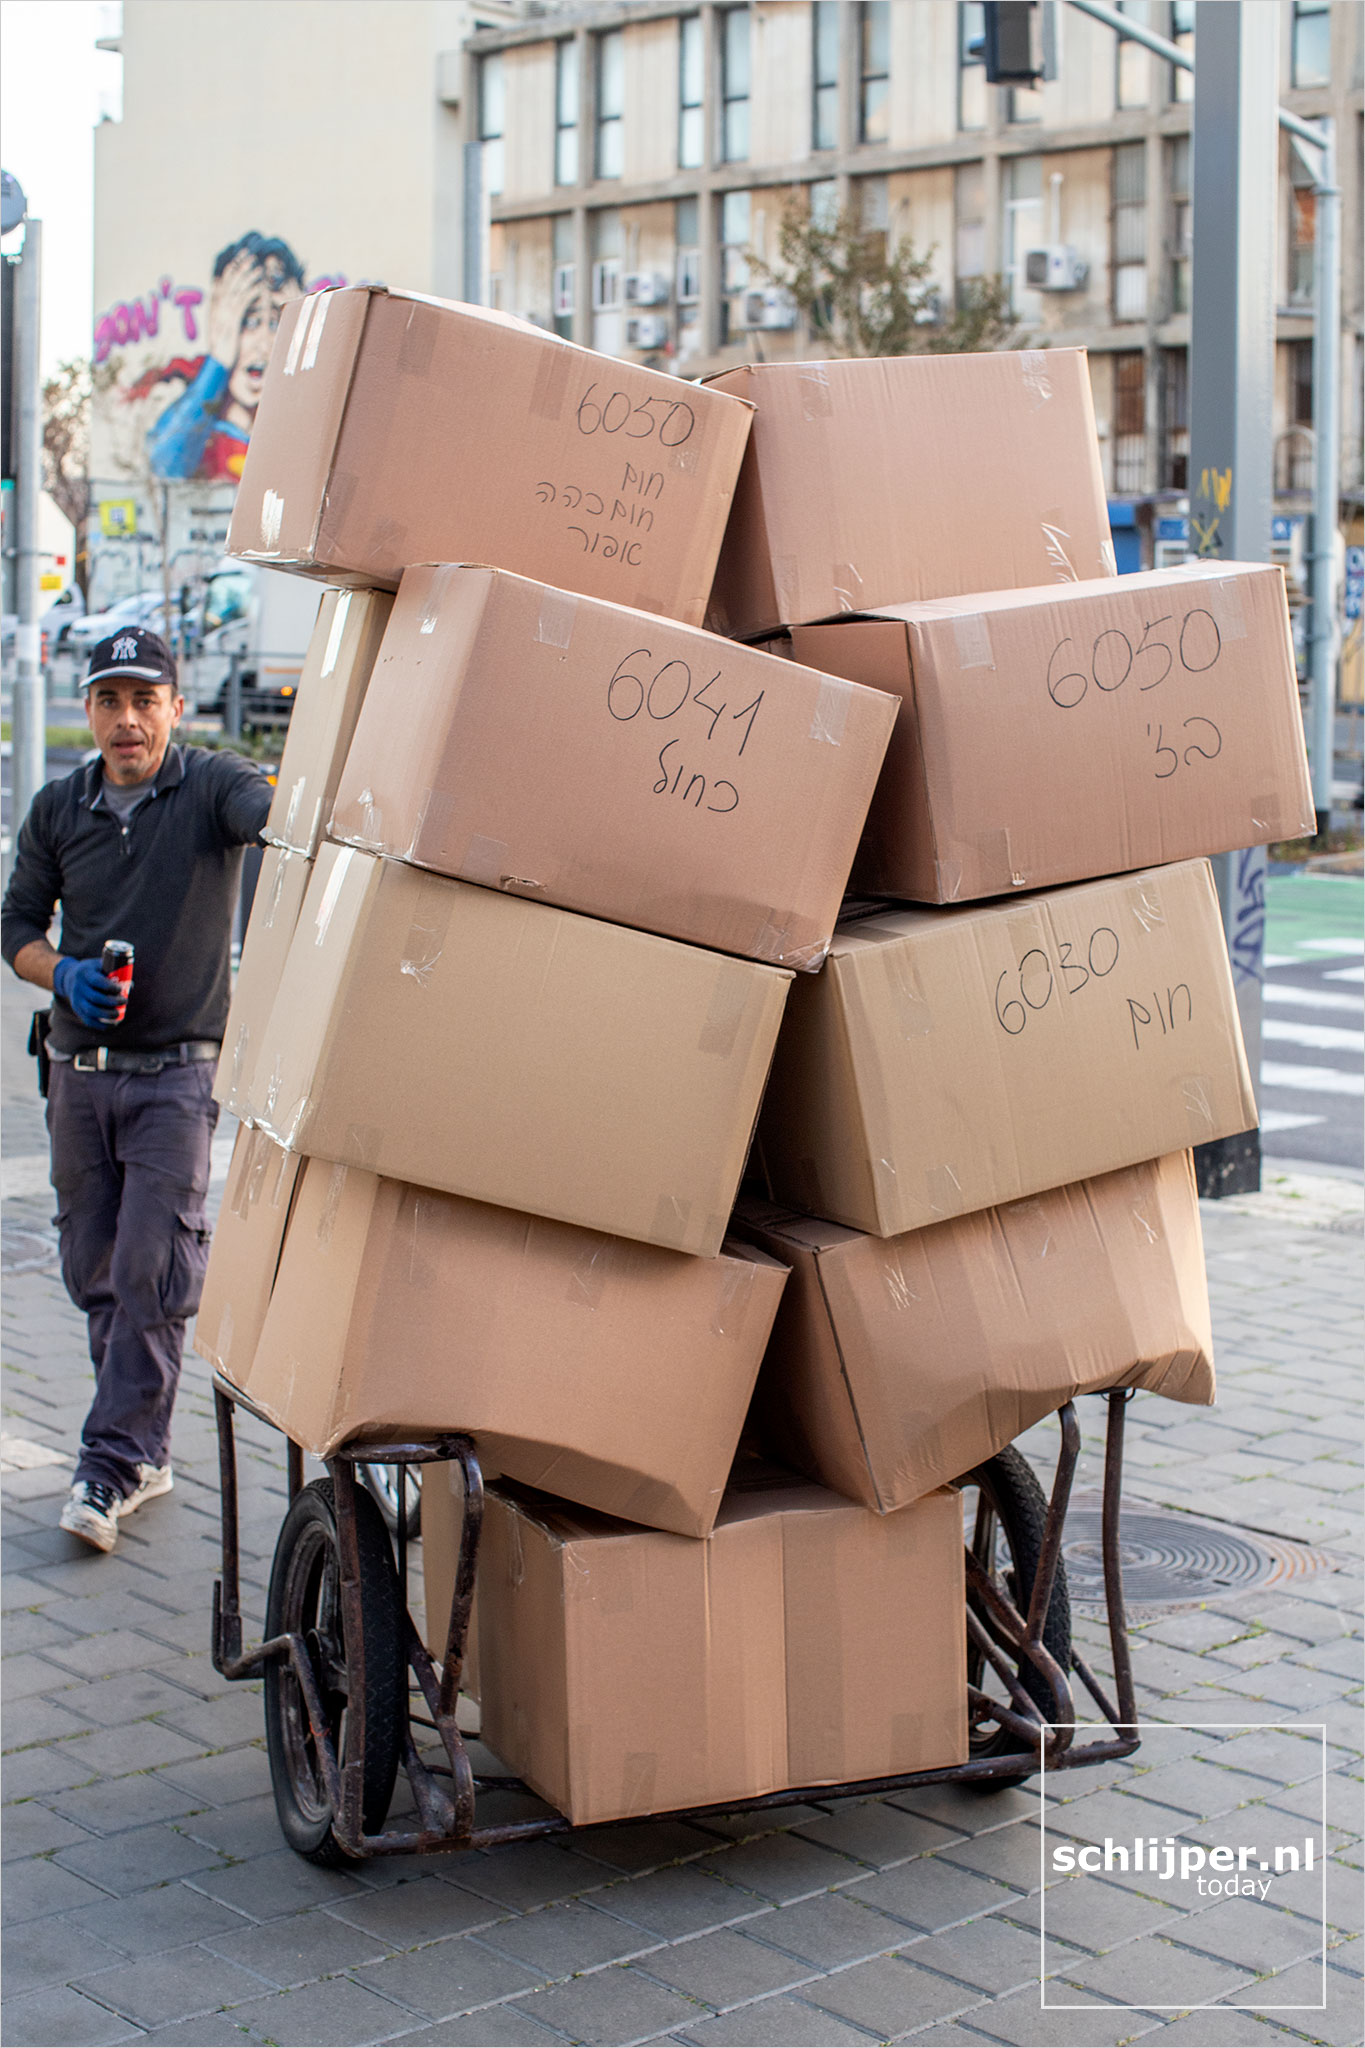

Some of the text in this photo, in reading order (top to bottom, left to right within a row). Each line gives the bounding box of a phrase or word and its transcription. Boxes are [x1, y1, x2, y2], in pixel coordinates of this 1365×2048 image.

[93, 275, 204, 364] DON'T
[576, 382, 696, 447] 6050
[535, 481, 655, 533] חום כהה
[621, 461, 665, 500] חום
[567, 525, 643, 567] אפור
[1046, 608, 1222, 709] 6050
[607, 648, 766, 757] 6041
[652, 738, 740, 813] כחול
[994, 927, 1120, 1036] 6030
[1126, 983, 1193, 1051] חום
